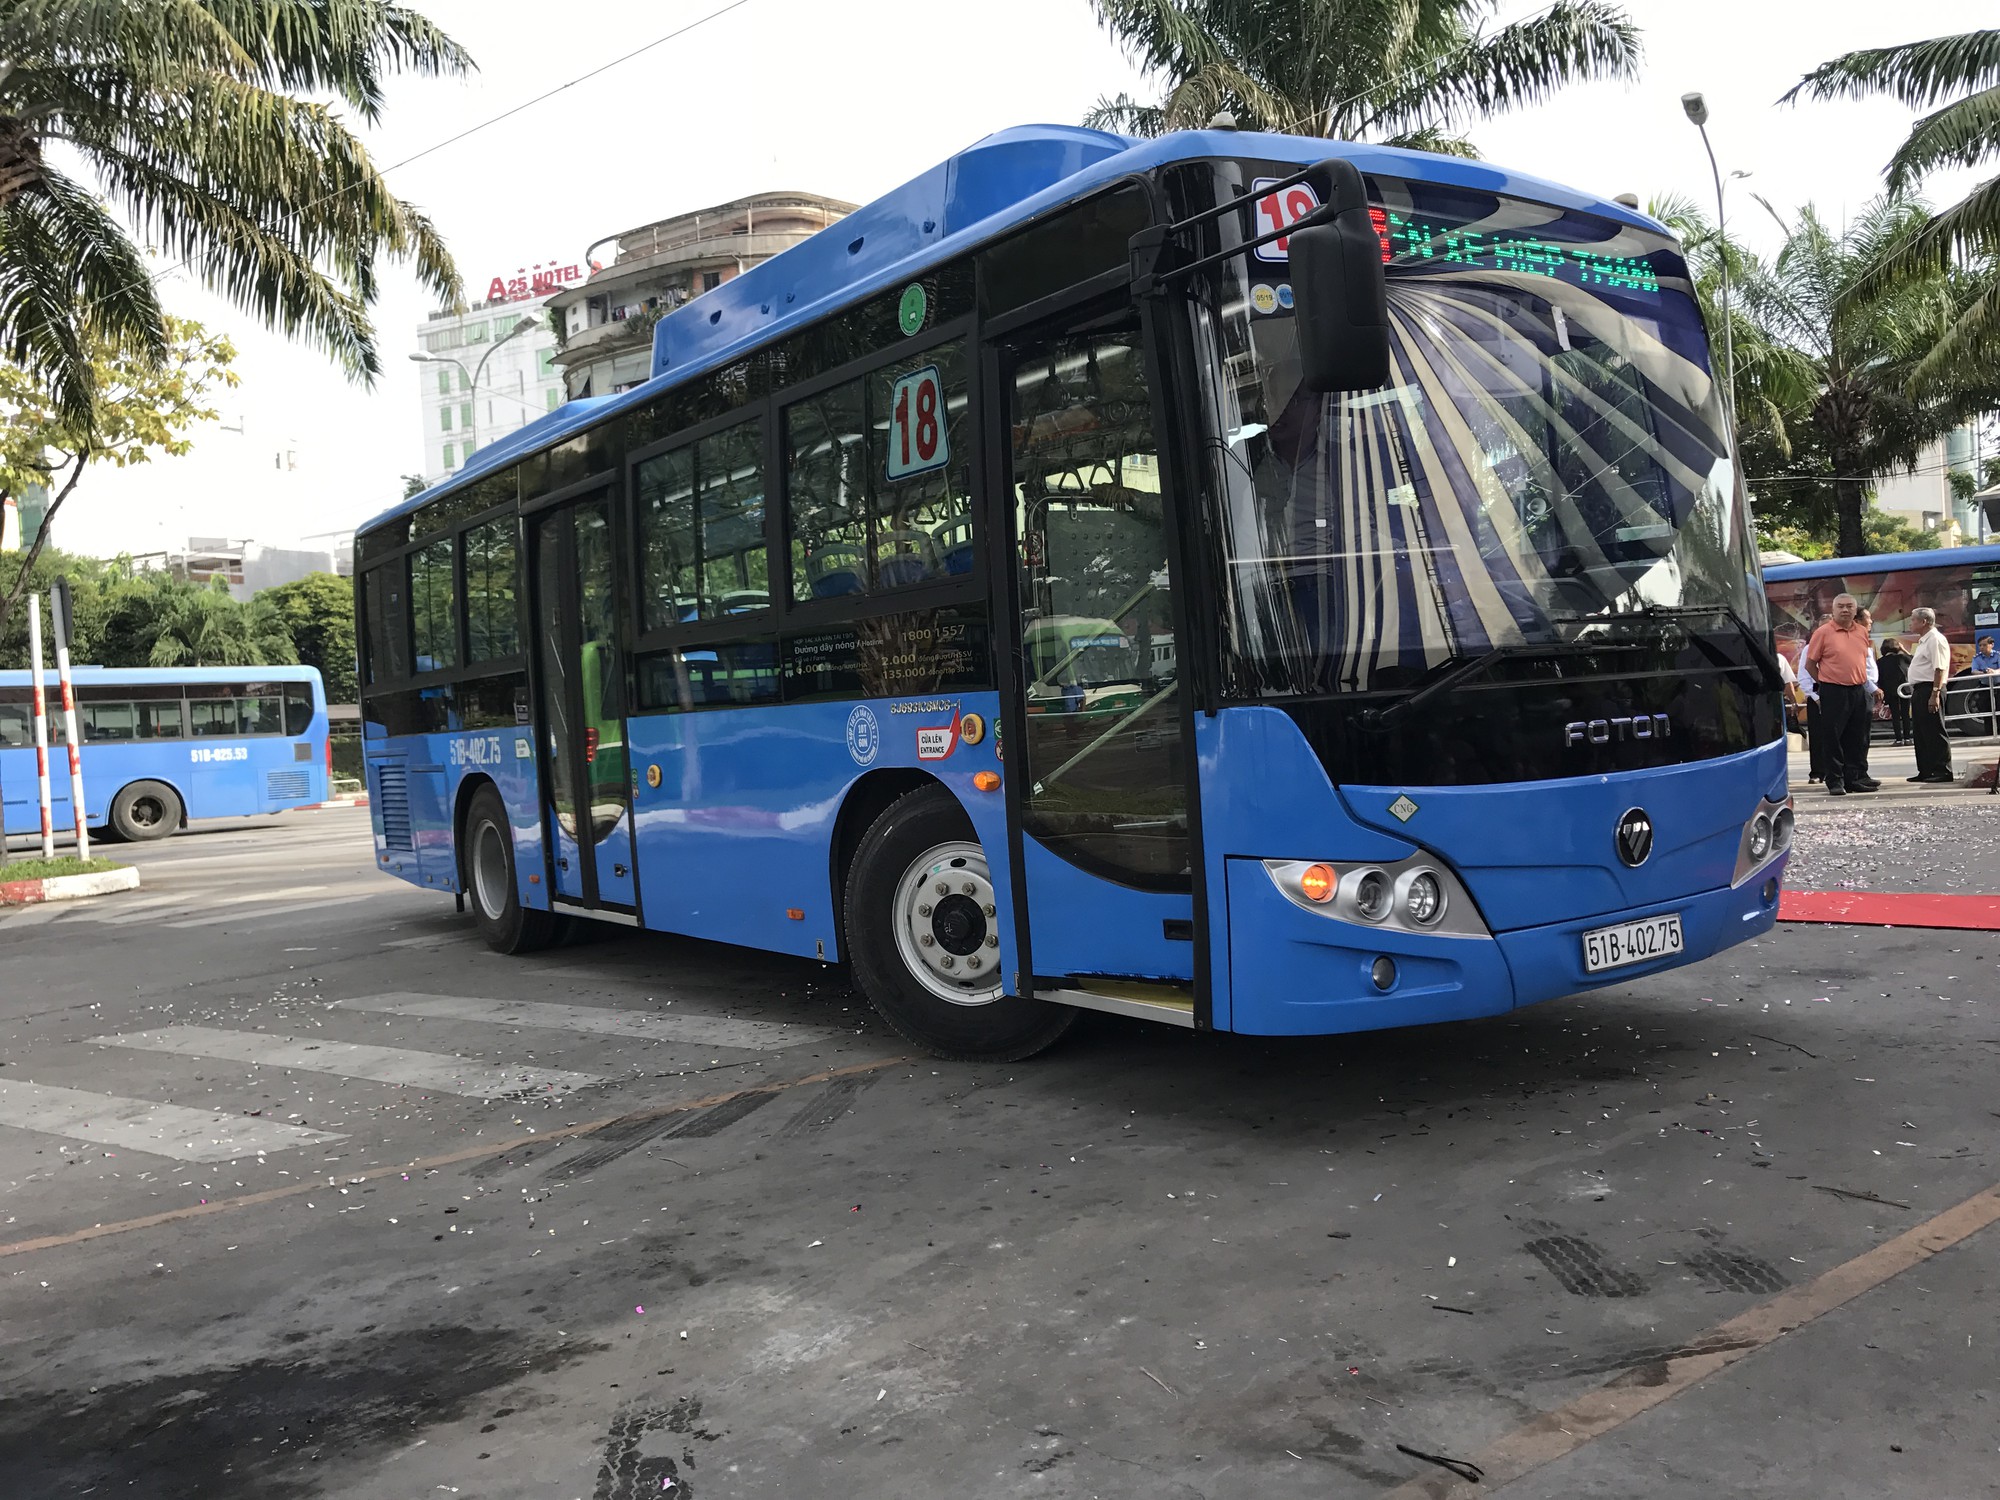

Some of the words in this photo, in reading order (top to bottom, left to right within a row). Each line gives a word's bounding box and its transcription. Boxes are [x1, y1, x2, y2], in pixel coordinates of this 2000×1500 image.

[533, 264, 583, 291] HOTEL
[895, 378, 938, 466] 18
[902, 628, 931, 641] 1800
[935, 624, 965, 637] 1557
[794, 644, 818, 655] Đường
[820, 642, 834, 652] dây
[835, 640, 855, 650] nóng
[861, 639, 884, 647] Hotline
[881, 653, 916, 666] 2.000
[883, 667, 926, 679] 135.000
[932, 733, 943, 744] LÊN
[1565, 713, 1671, 748] FOTON
[449, 736, 502, 766] 51B-402.75
[920, 746, 945, 754] ENTRANCE
[1394, 803, 1413, 814] CNG
